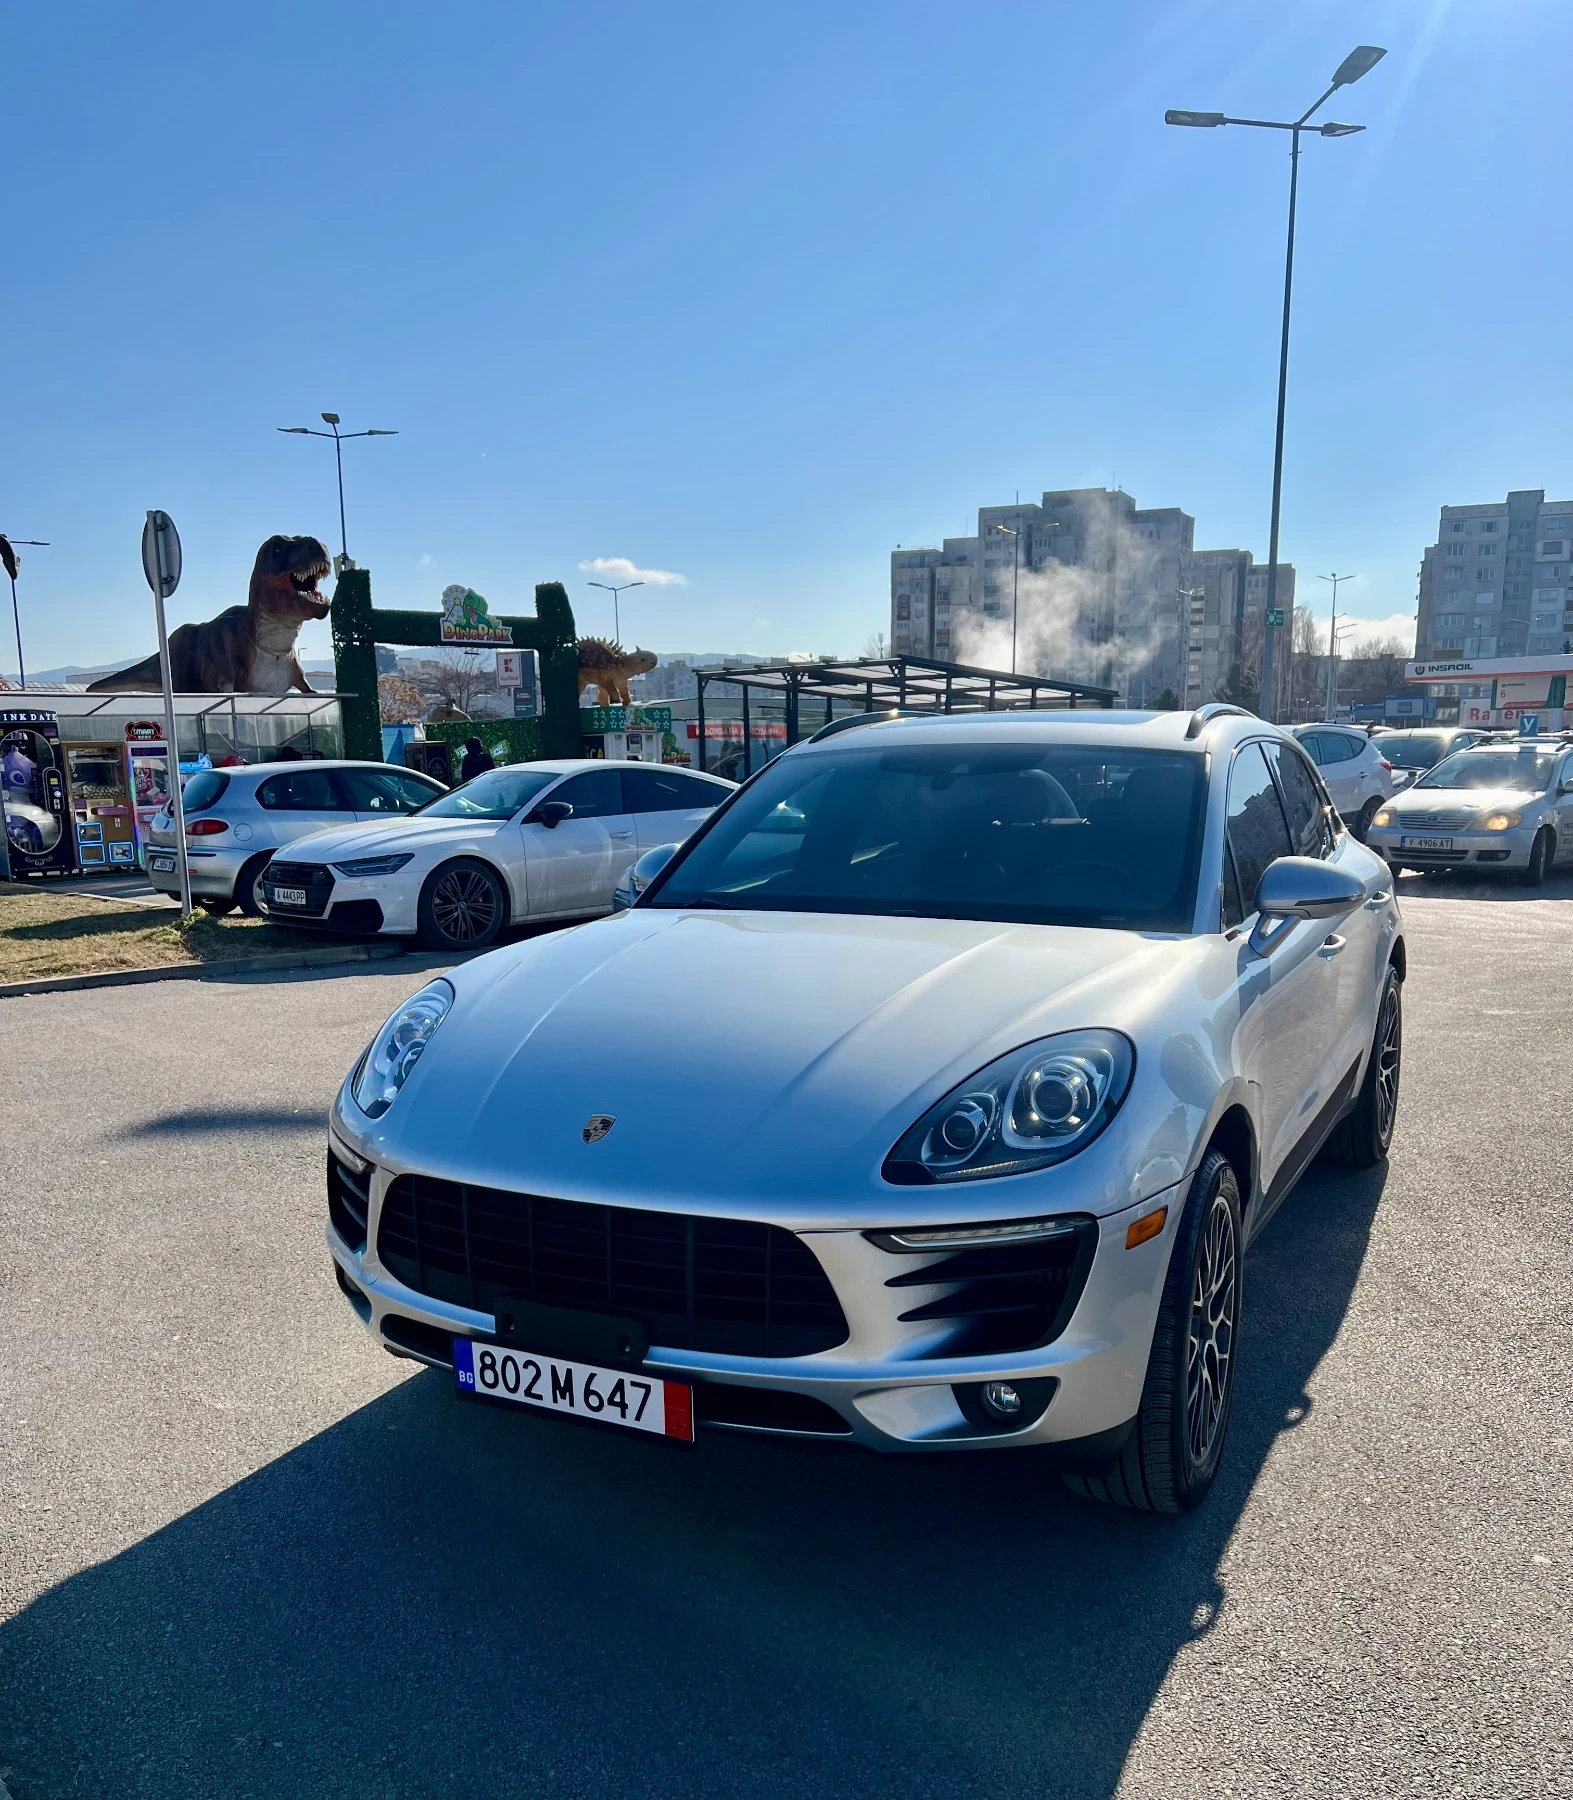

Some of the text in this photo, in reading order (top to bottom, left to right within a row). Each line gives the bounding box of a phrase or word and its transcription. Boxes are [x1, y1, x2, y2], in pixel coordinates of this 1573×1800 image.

[1428, 663, 1473, 672] INSAOIL
[30, 713, 57, 721] DATE
[1469, 707, 1526, 721] Raen
[458, 1369, 474, 1384] BG
